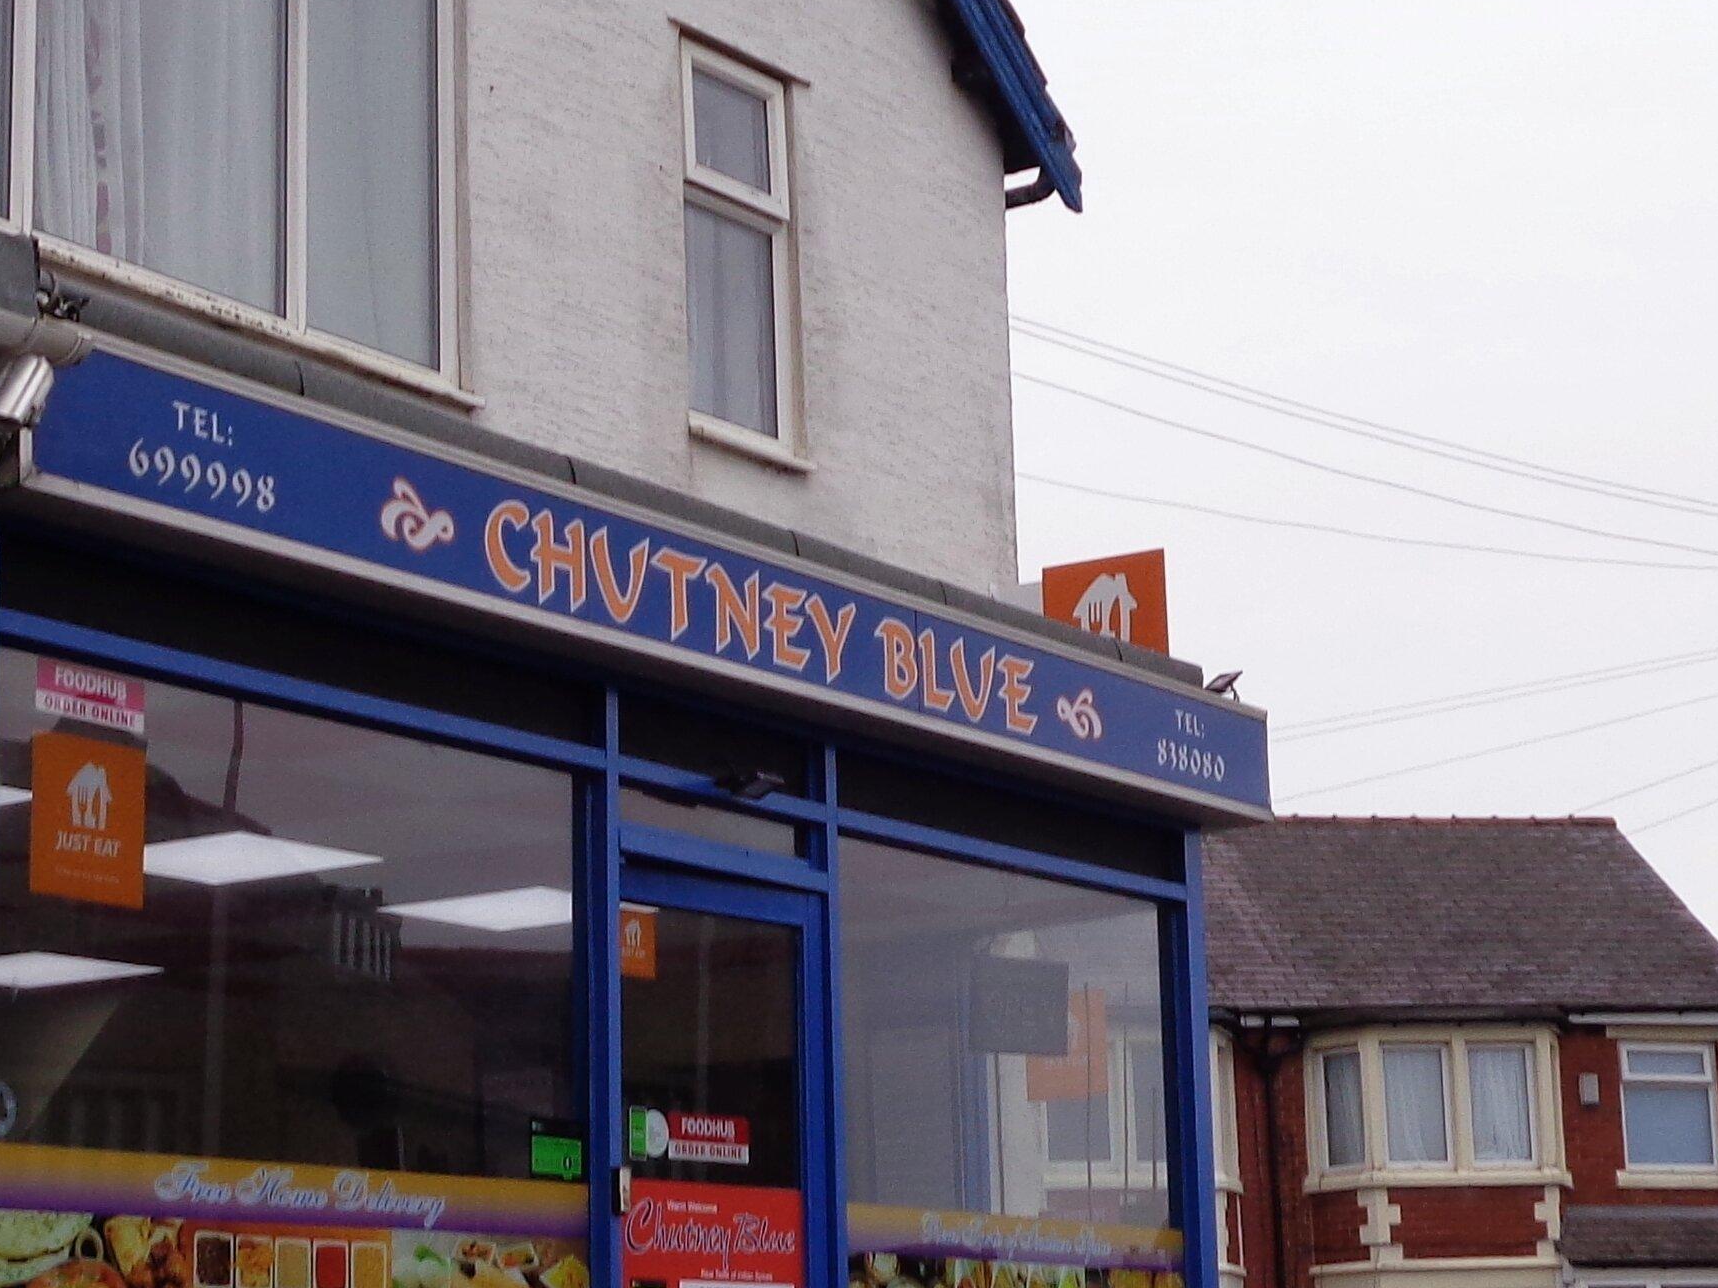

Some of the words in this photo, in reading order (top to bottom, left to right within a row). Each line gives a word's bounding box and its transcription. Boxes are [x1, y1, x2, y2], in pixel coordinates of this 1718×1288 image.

[171, 399, 233, 447] TEL:
[128, 437, 277, 513] 699998
[484, 498, 856, 685] CHUTNEY
[875, 601, 1040, 737] BLUE
[55, 663, 127, 702] FOODHUB
[43, 693, 87, 717] ORDER
[90, 705, 136, 729] ONLINE
[1175, 709, 1205, 739] TEL:
[1157, 736, 1225, 782] 838080
[55, 829, 91, 852] JUST
[94, 837, 122, 858] EAT
[681, 1116, 737, 1137] FOODHUB
[675, 1144, 708, 1160] ORDER
[709, 1145, 742, 1161] ONLINE
[154, 1161, 232, 1205] Free
[235, 1166, 329, 1209] Home
[332, 1168, 447, 1229] Delivery
[625, 1196, 731, 1270] Chutney
[732, 1211, 795, 1255] Blue
